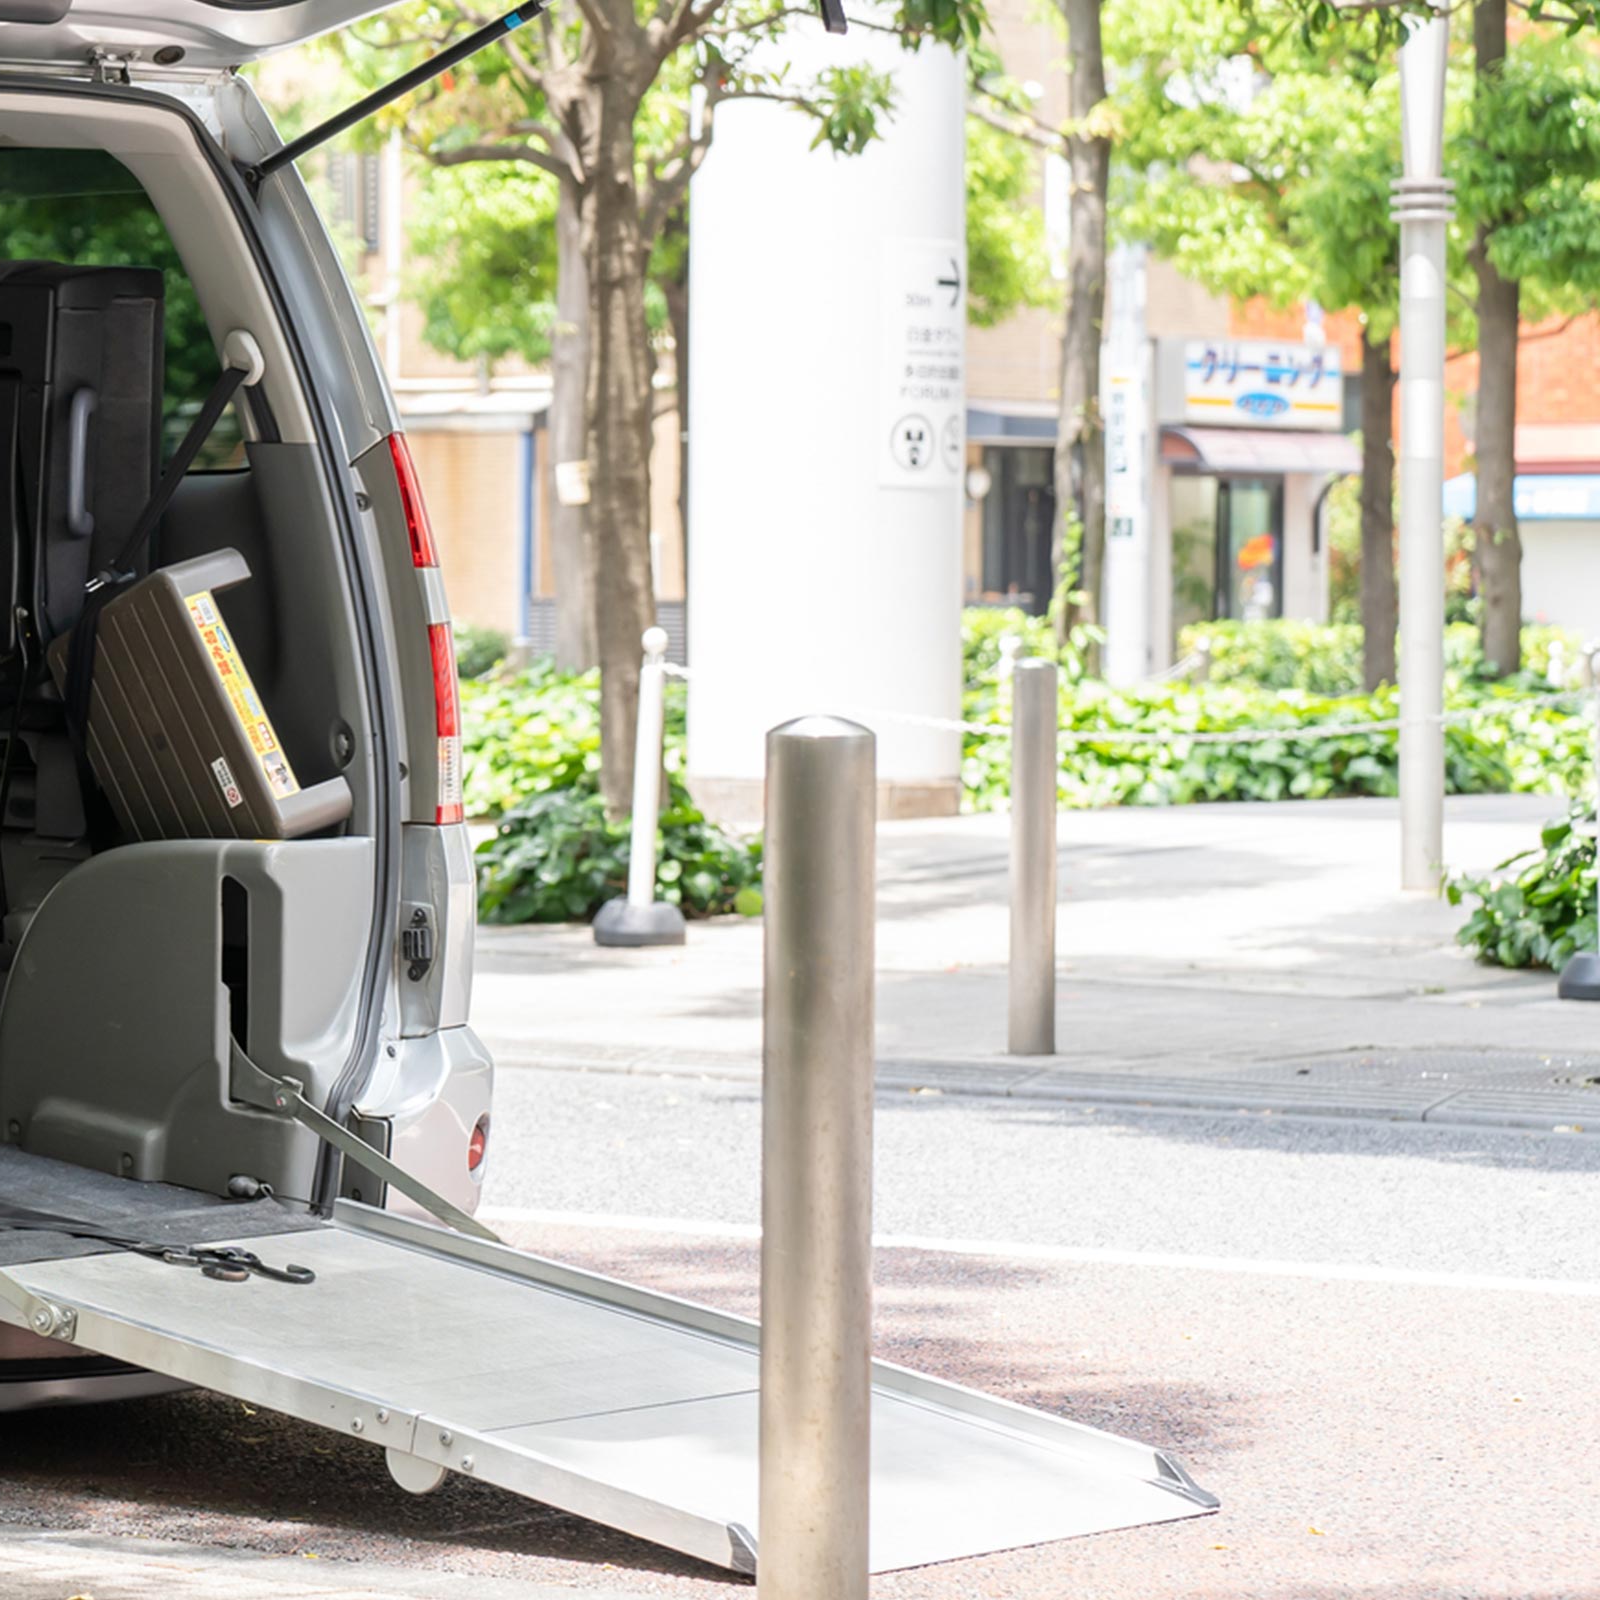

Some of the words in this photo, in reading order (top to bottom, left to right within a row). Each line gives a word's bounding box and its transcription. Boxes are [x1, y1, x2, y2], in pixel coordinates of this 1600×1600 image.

[1203, 345, 1324, 388] クリーニング
